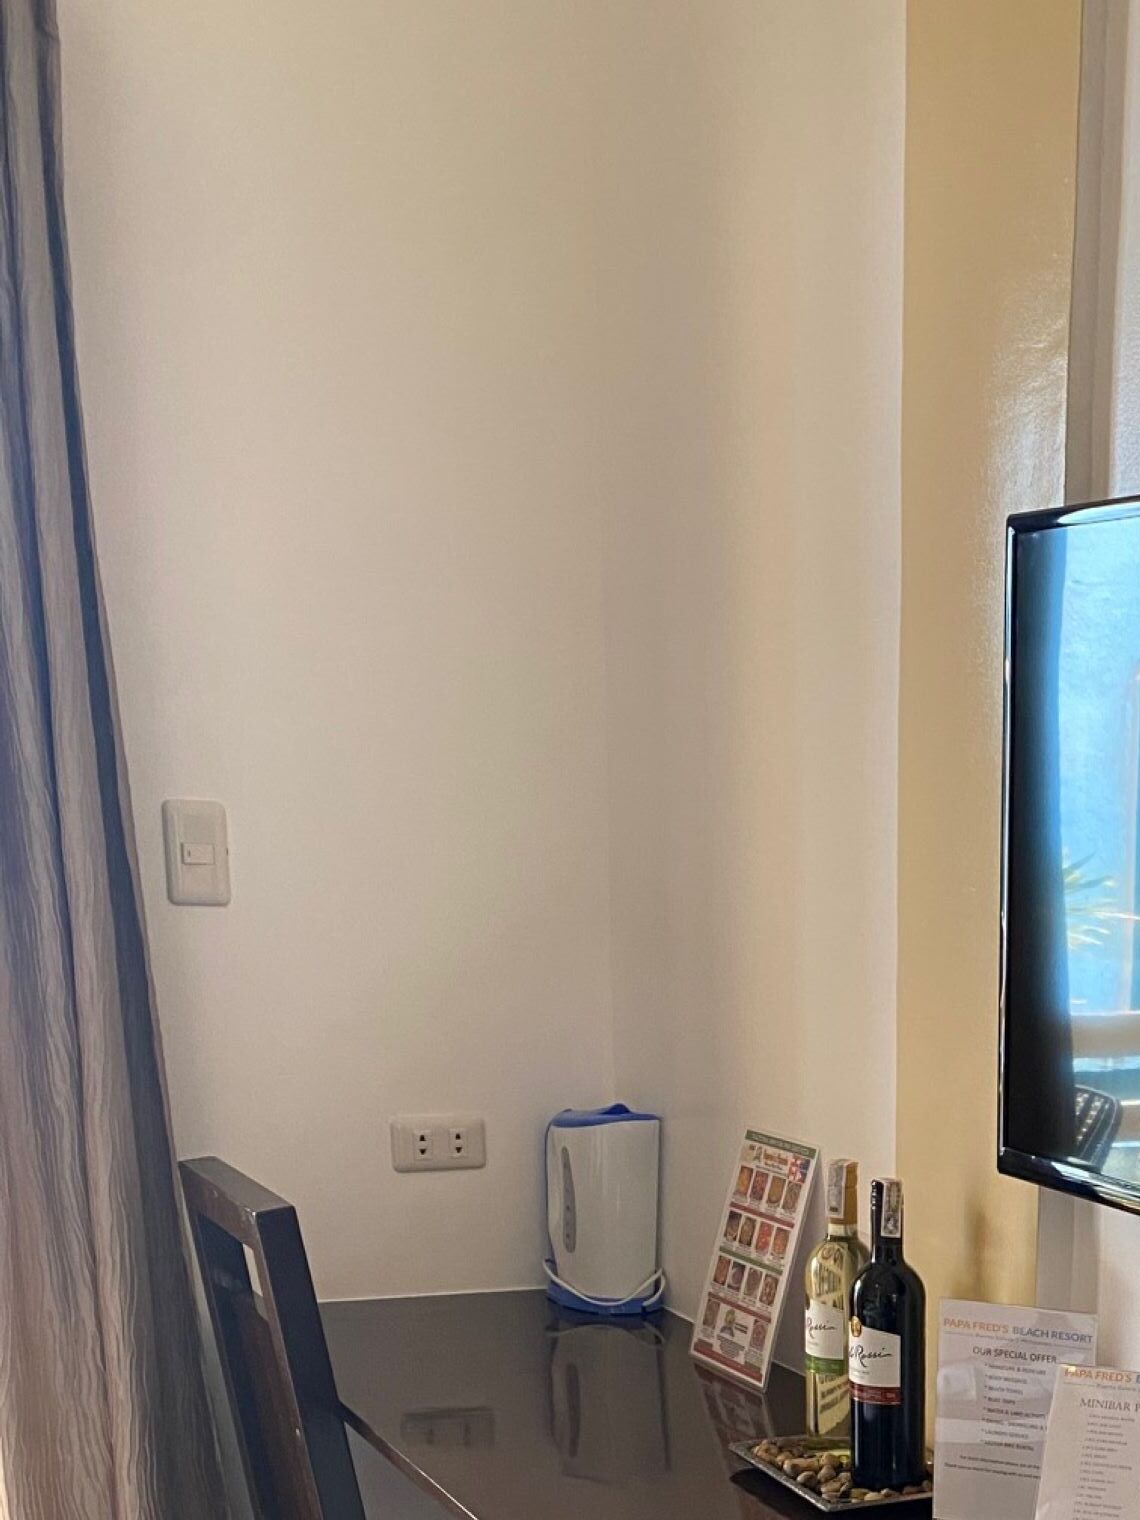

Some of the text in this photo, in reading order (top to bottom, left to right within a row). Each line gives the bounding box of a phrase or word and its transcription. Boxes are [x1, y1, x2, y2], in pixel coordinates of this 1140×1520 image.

[943, 1317, 971, 1329] PAPA
[972, 1321, 1009, 1334] FRED'S
[1012, 1326, 1049, 1338] BEACH
[1050, 1330, 1094, 1344] RESORT
[972, 1346, 1057, 1364] OUR SPECIAL OFFER
[1064, 1367, 1093, 1379] PAPA
[1094, 1370, 1132, 1384] FRED'S
[1079, 1398, 1131, 1412] MINIBAR
